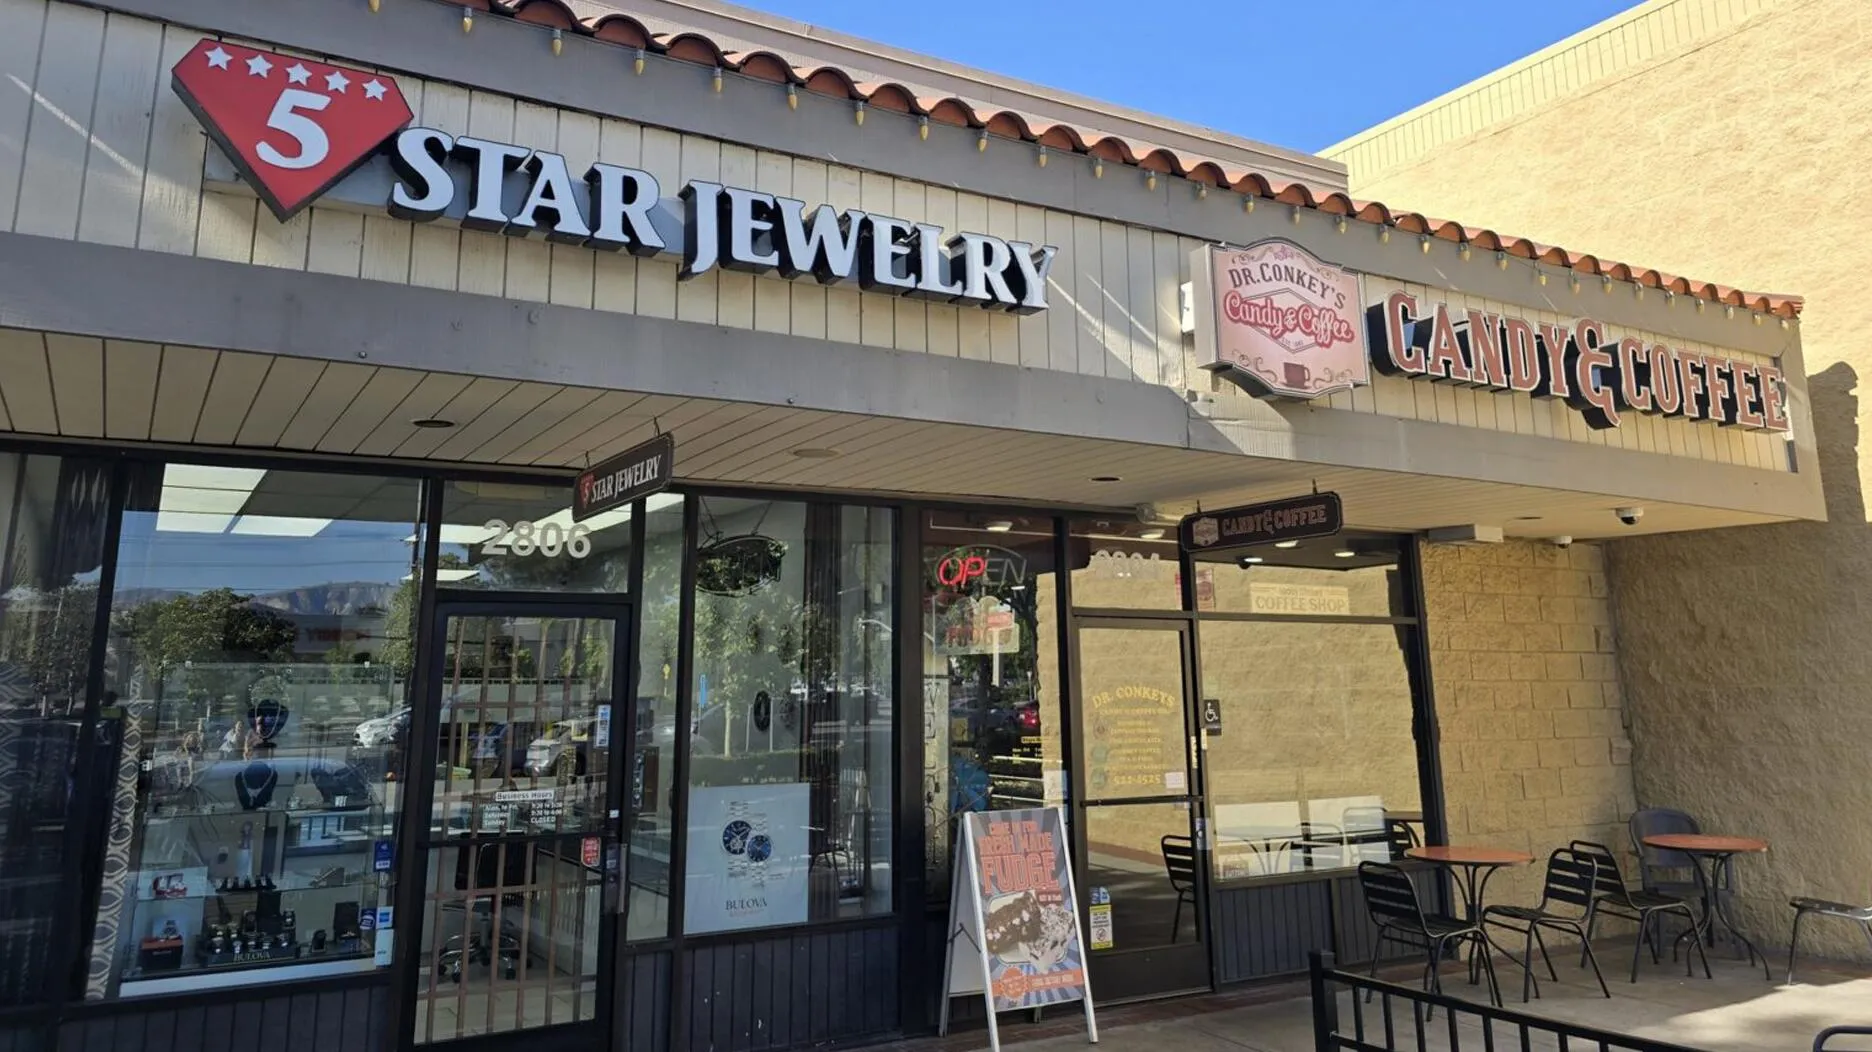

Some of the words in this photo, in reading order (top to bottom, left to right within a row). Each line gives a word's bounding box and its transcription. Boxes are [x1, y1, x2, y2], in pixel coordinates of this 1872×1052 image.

[256, 88, 331, 169] 5
[393, 127, 666, 249] STAR
[686, 179, 1059, 309] JEWELRY
[1228, 267, 1260, 288] DR.
[1260, 263, 1346, 310] CONKEY'S
[1225, 290, 1284, 339] Candy
[1298, 303, 1355, 348] Coffee
[1386, 291, 1570, 398] CANDY
[1574, 316, 1623, 429] &
[1618, 336, 1791, 433] COFFEE
[591, 475, 614, 503] STAR
[614, 454, 661, 500] JEWELRY
[481, 518, 592, 559] 2806
[1222, 513, 1263, 537] CANDY
[1273, 504, 1327, 530] COFFEE
[937, 556, 1028, 590] OPEN
[1256, 595, 1306, 611] COFFEE
[1309, 598, 1347, 613] SHOP
[1093, 692, 1112, 708] DR.
[496, 790, 530, 800] Business
[531, 789, 553, 799] Hours
[980, 852, 1058, 894] FUDGE
[725, 898, 768, 911] BULOVA
